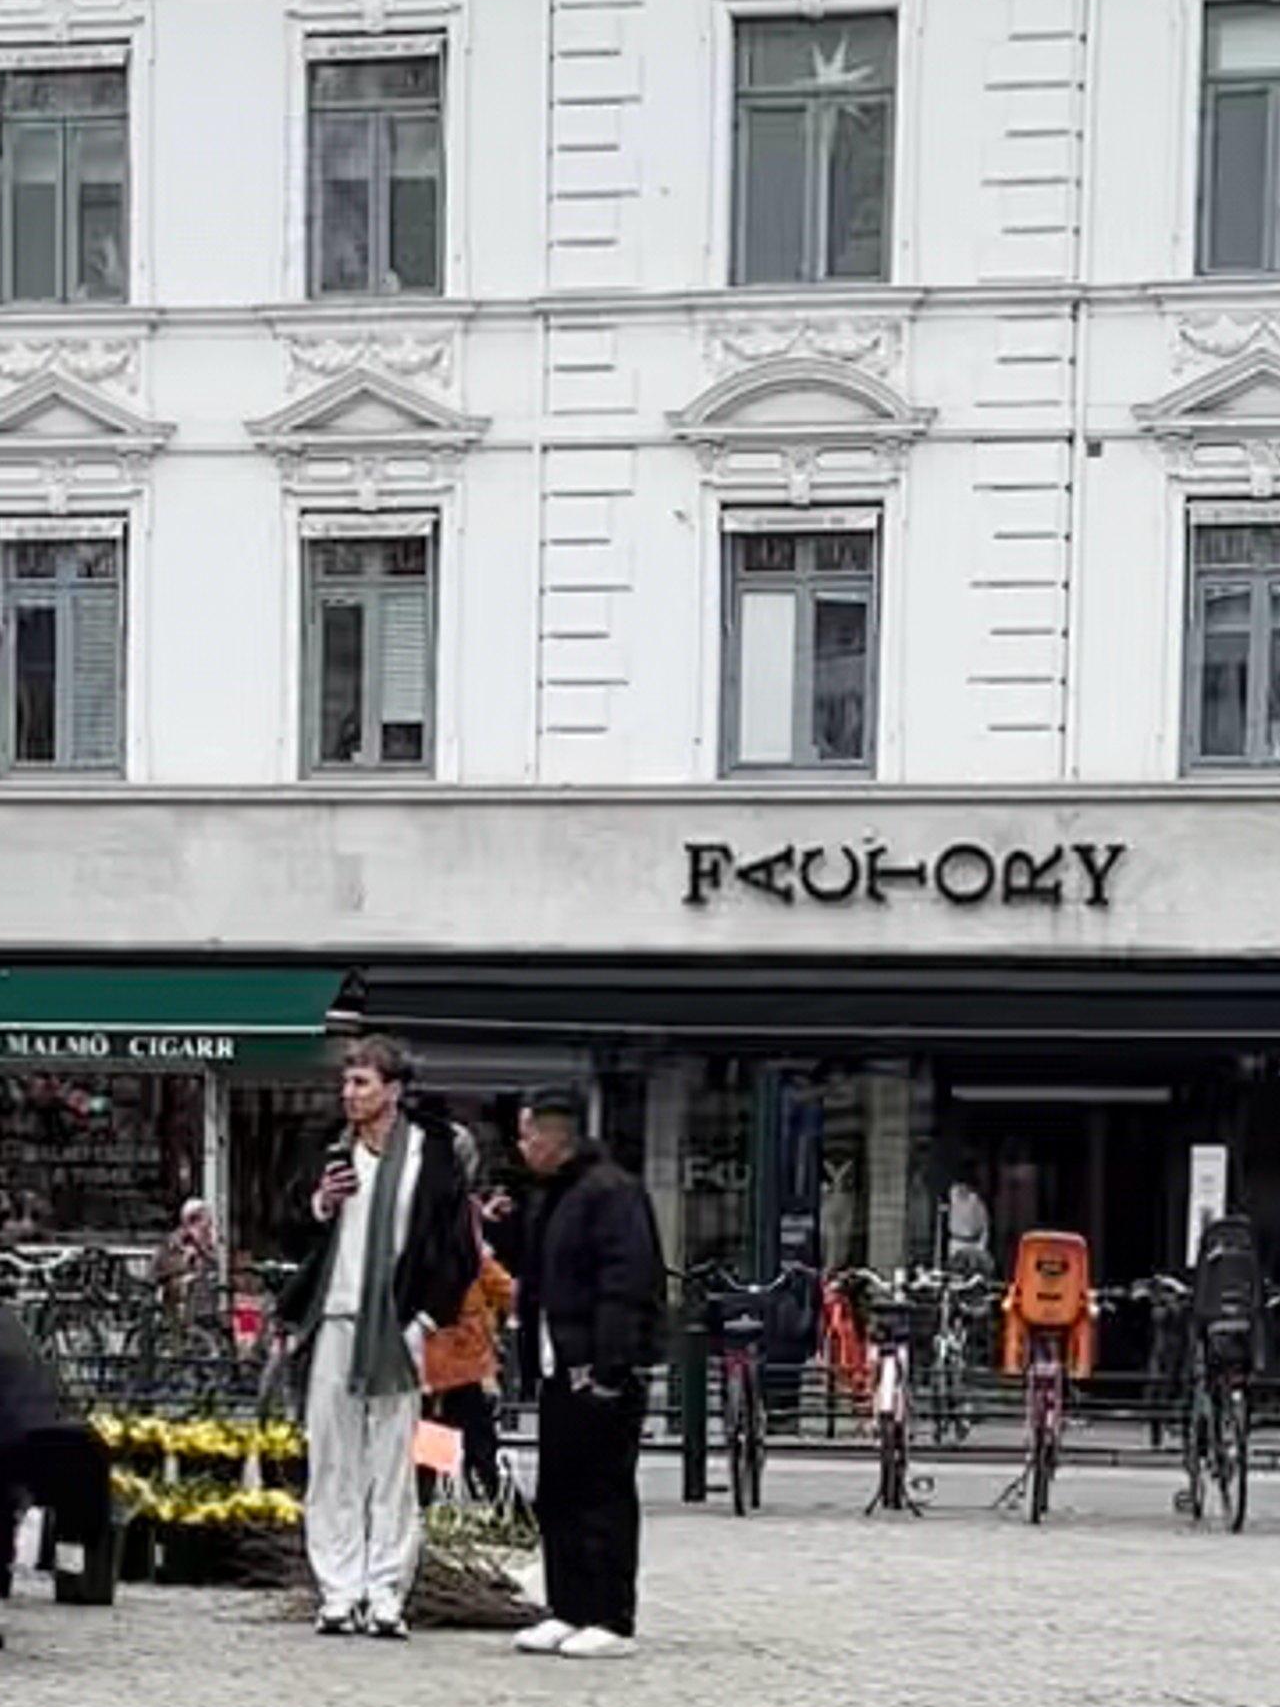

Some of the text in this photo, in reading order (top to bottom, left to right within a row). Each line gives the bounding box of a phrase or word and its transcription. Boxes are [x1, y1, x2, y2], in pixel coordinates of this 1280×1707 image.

[682, 842, 1126, 906] FACTORY
[6, 1033, 235, 1059] MALMÖ CIGARR
